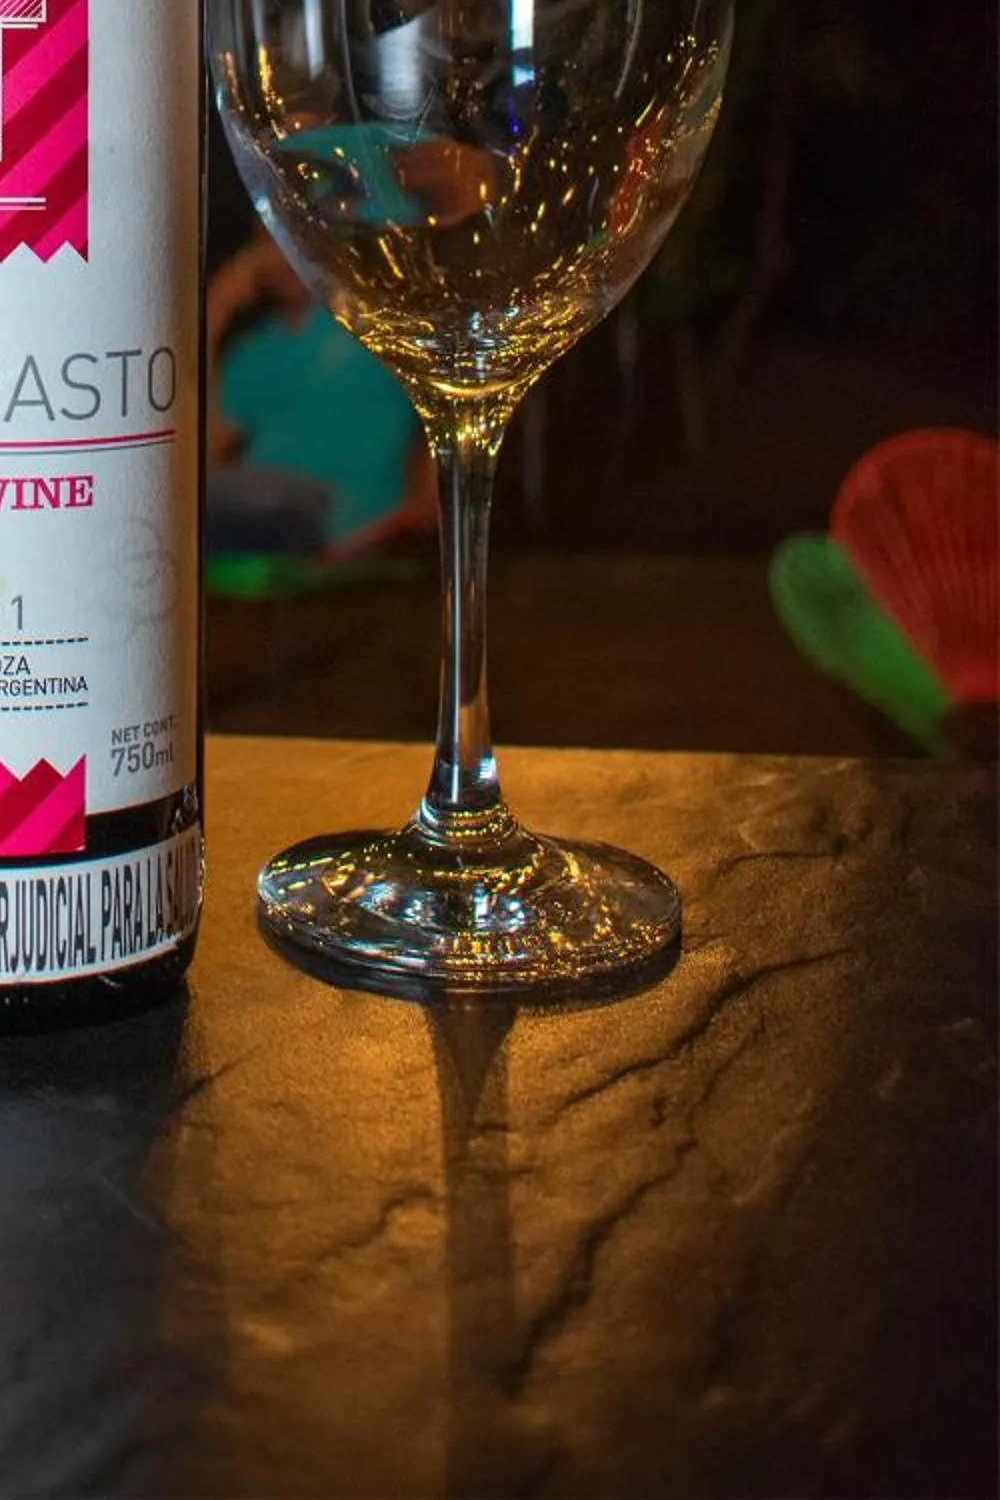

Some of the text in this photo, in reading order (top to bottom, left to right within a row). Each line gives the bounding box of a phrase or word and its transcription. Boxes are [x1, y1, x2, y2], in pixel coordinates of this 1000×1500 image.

[111, 725, 141, 746] NET
[110, 740, 175, 777] 750ml
[101, 862, 144, 962] PARA
[147, 852, 165, 949] LA
